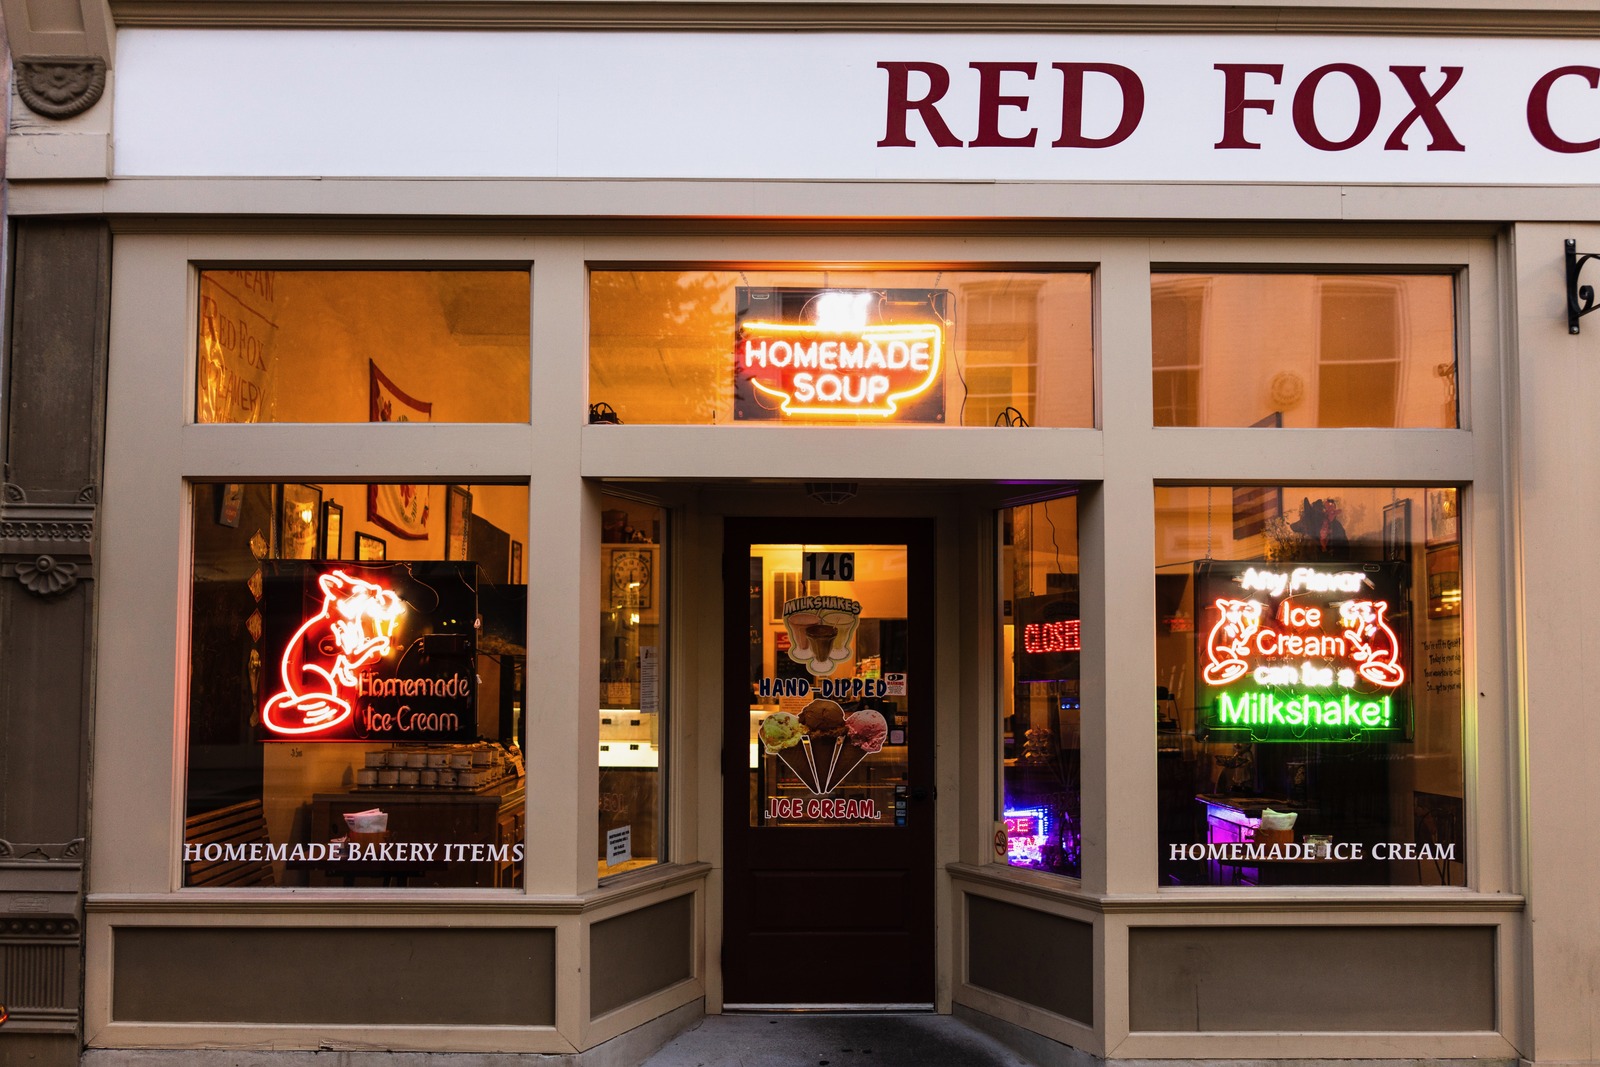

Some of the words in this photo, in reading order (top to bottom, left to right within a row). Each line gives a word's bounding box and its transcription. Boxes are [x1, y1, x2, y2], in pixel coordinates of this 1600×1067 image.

[876, 61, 1145, 149] RED
[1212, 62, 1465, 152] FOX
[239, 319, 267, 371] FOX
[745, 340, 929, 370] HOMEMADE
[793, 372, 889, 403] SOUP
[806, 552, 853, 580] 146
[1241, 567, 1288, 597] Any
[784, 596, 861, 616] MILKSHAKES
[1284, 601, 1321, 627] Ice
[1256, 629, 1345, 656] Cream
[359, 671, 470, 697] Homemade
[1253, 665, 1299, 686] can
[1300, 660, 1334, 687] be
[759, 678, 887, 698] HAND-DIPPED
[364, 704, 392, 731] Ice
[397, 705, 459, 732] Cream
[1219, 691, 1391, 727] Milkshake!
[771, 798, 803, 819] ICE
[807, 798, 875, 819] CREAM
[182, 842, 342, 862] HOMEMADE
[347, 842, 438, 862] BAKERY
[443, 843, 524, 862] ITEMS
[1169, 843, 1316, 861] HOMEMADE
[1325, 843, 1363, 861] ICE
[1371, 843, 1456, 861] CREAM
